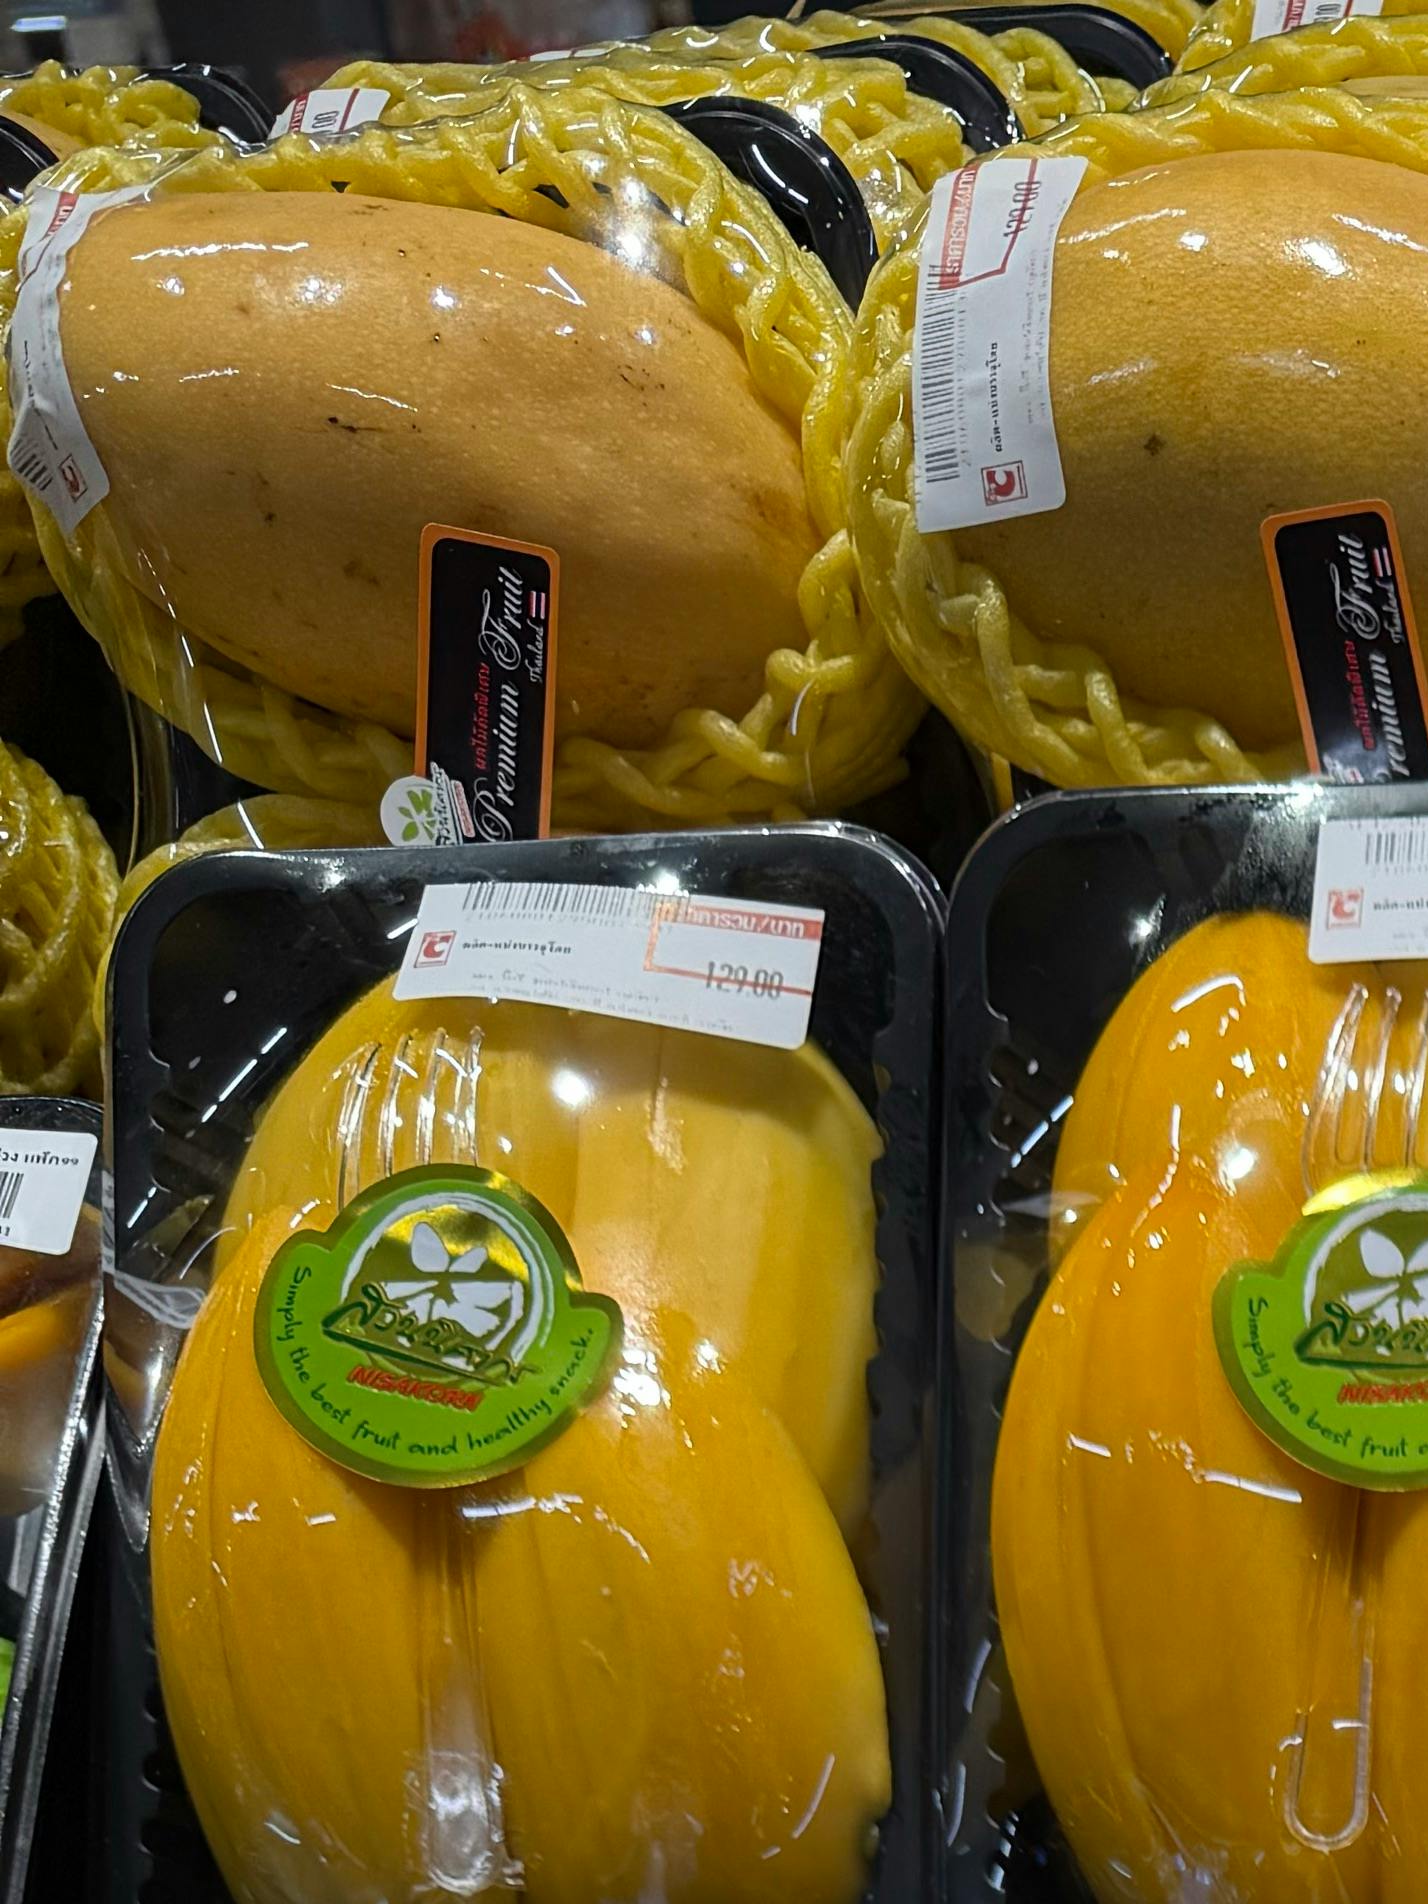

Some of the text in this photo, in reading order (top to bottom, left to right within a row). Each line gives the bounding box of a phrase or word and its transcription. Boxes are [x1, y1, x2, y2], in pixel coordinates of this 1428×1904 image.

[1330, 535, 1380, 640] Fruit
[1376, 579, 1404, 643] Thailand
[525, 620, 544, 682] Thailand
[473, 567, 523, 842] Premium Fruit
[705, 960, 784, 1000] 129.00
[276, 1263, 593, 1453] Simply the best fruit and healthy snack.
[347, 1366, 482, 1412] NISAKORN
[1243, 1298, 1273, 1377] Simply
[1275, 1378, 1300, 1415] the
[1307, 1413, 1353, 1446] best
[1360, 1438, 1409, 1457] fruit
